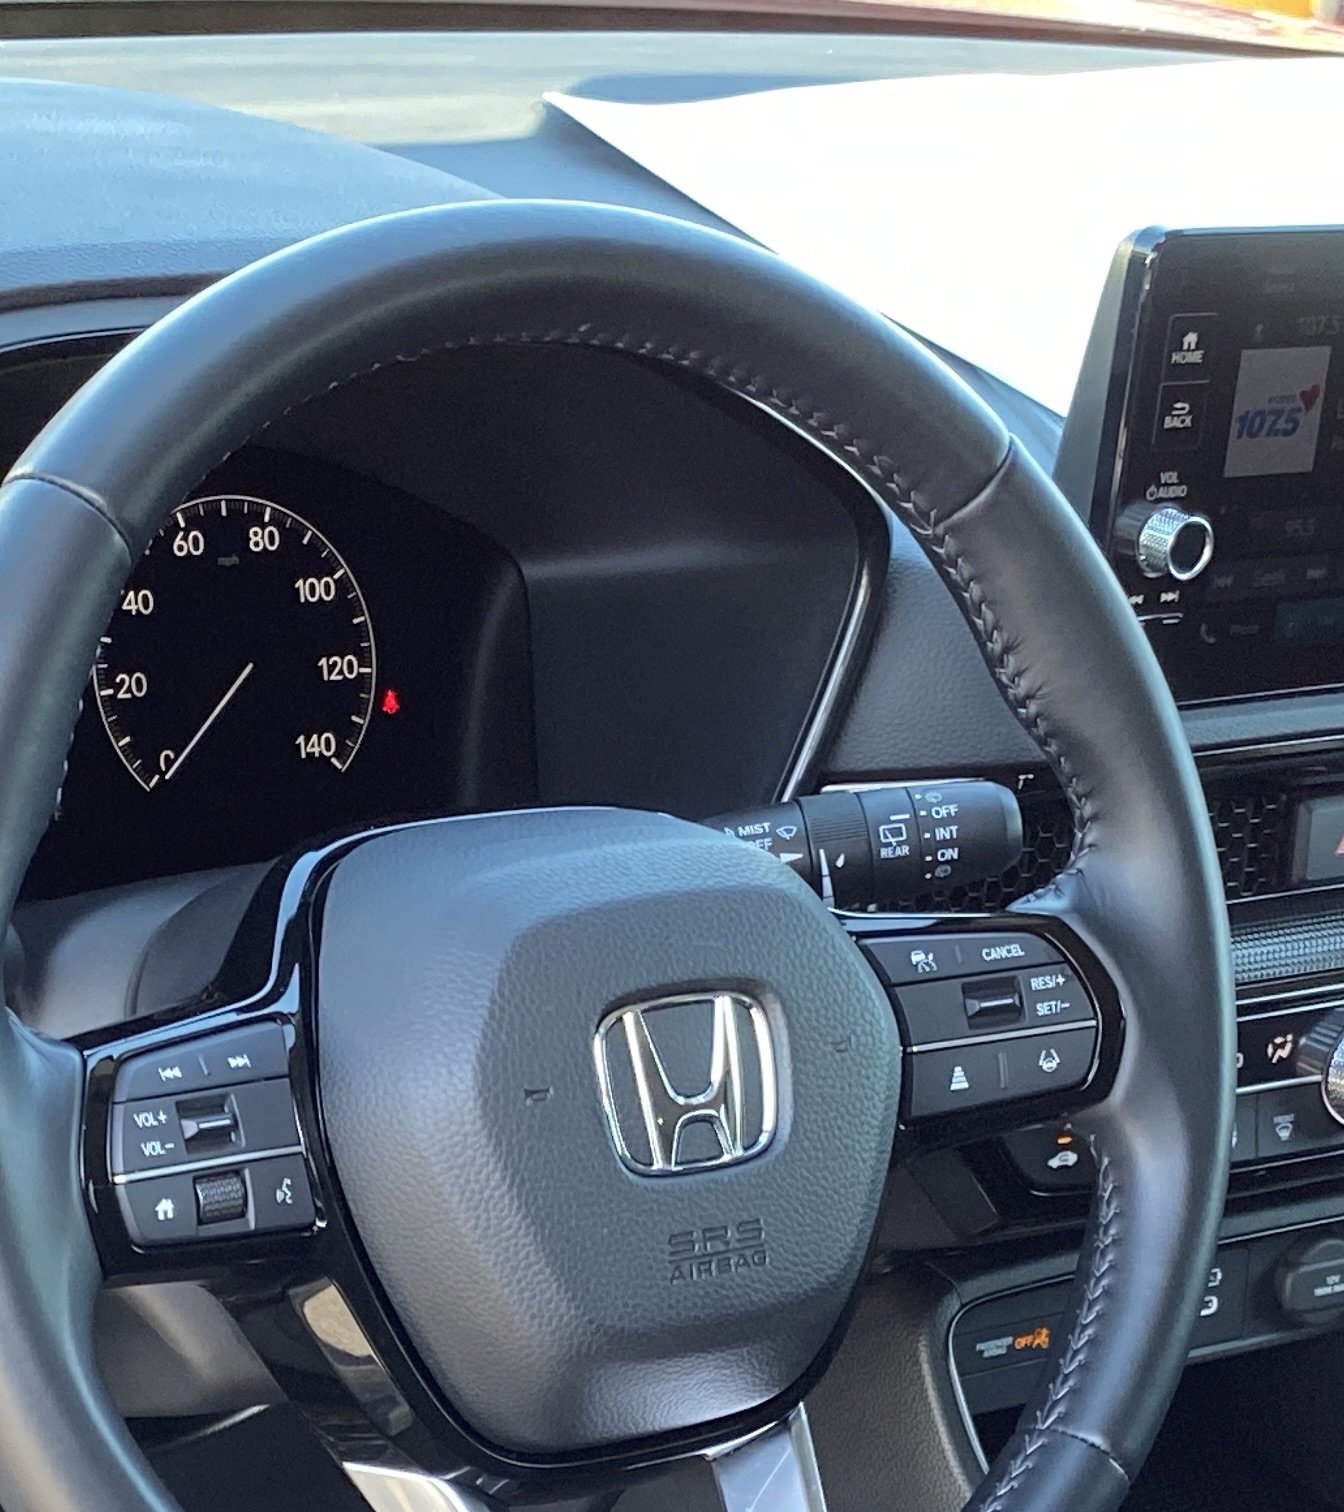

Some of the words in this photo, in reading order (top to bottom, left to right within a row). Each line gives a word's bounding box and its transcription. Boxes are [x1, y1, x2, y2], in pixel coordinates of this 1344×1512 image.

[1171, 350, 1204, 364] HOME
[1163, 415, 1193, 429] BACK
[1160, 471, 1180, 484] VOL
[1156, 485, 1188, 498] AUDIO
[172, 530, 205, 557] 60
[248, 526, 281, 553] 80
[294, 577, 337, 603] 100
[121, 589, 154, 615] 40
[317, 655, 359, 681] 120
[114, 673, 148, 699] 20
[295, 732, 337, 759] 140
[931, 804, 959, 819] OFF
[736, 821, 772, 838] MIST
[935, 825, 959, 841] INT
[880, 844, 910, 859] REAR
[937, 847, 960, 862] ON
[981, 943, 1026, 961] CANCEL
[1030, 974, 1067, 992] RES/+
[667, 1217, 766, 1255] SRS
[669, 1252, 769, 1285] AIRBAG
